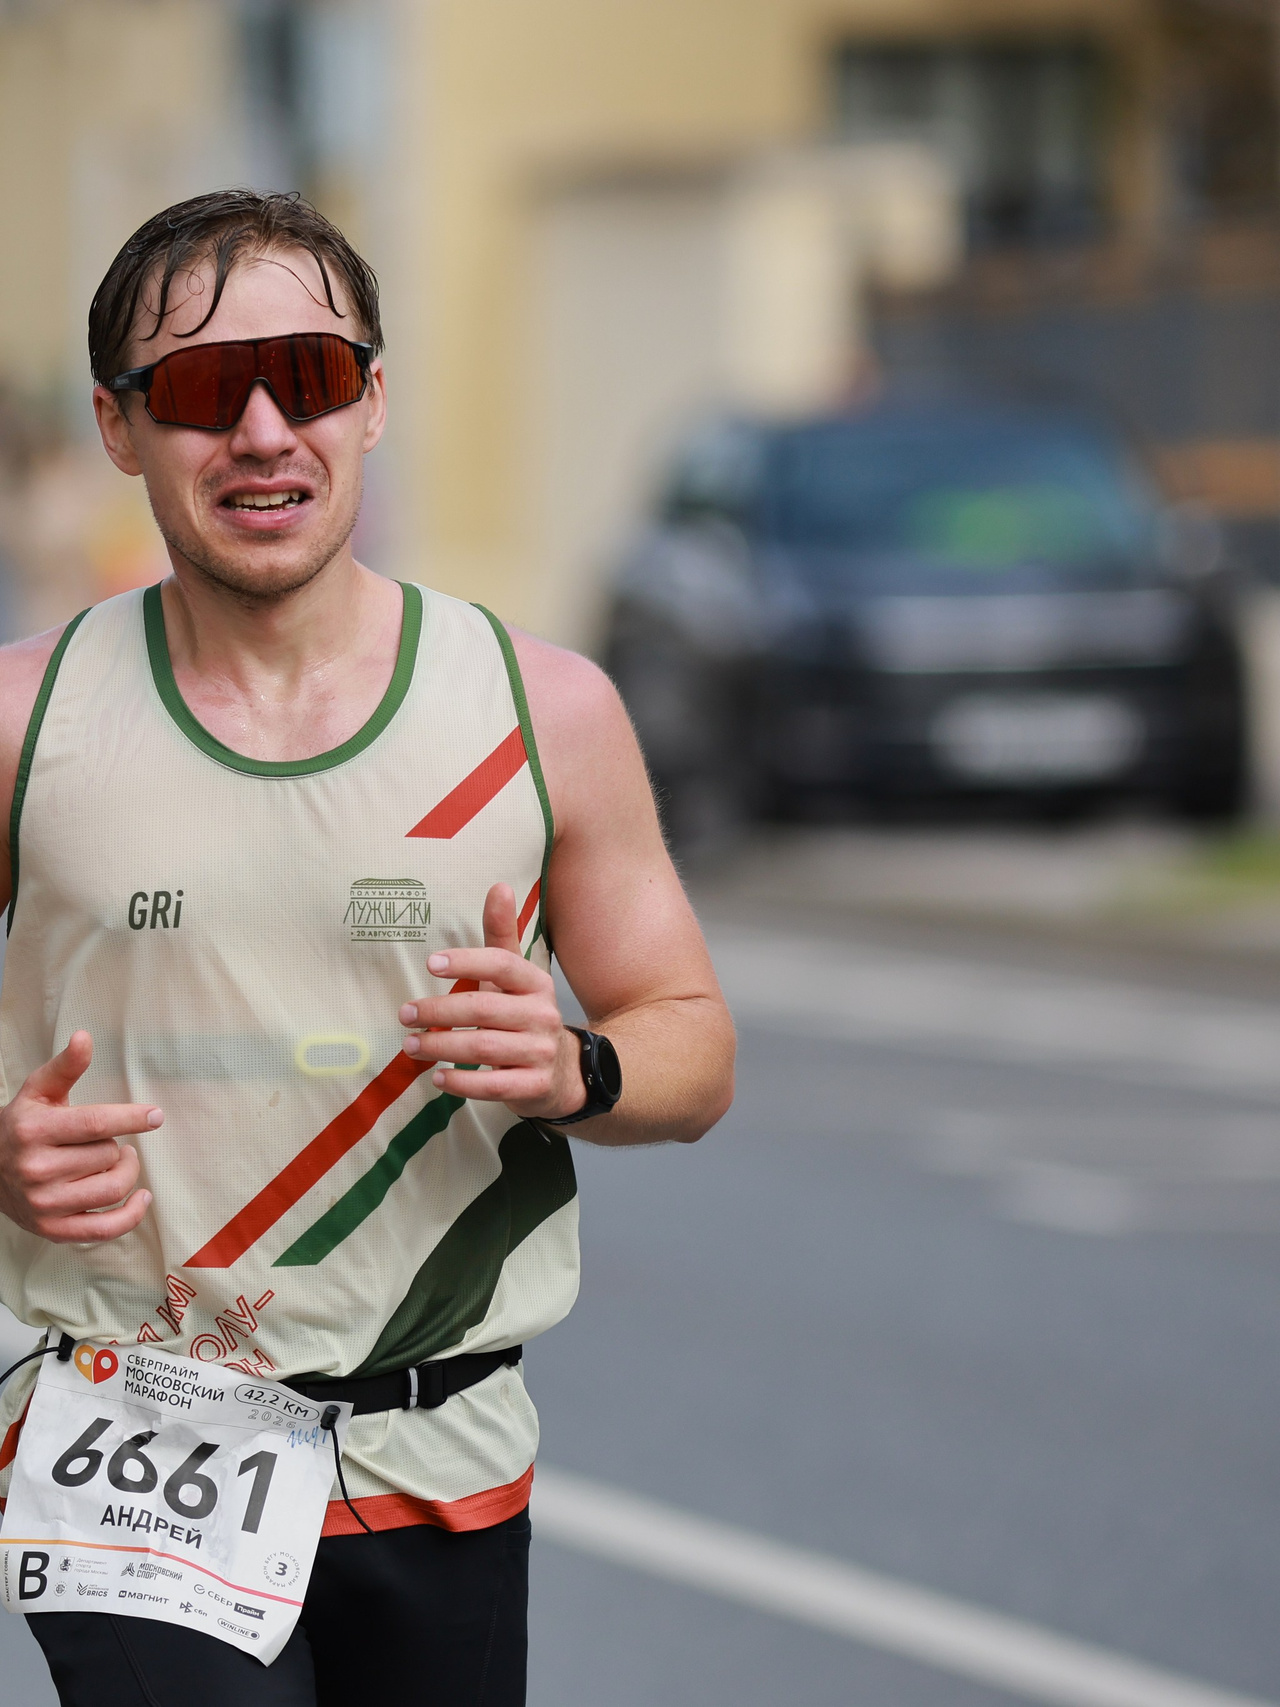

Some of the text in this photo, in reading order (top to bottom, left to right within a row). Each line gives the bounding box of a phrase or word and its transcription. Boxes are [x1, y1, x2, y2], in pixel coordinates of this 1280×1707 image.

[128, 889, 184, 931] GRi
[343, 900, 431, 925] ЛУЖНИКИ
[190, 1289, 275, 1363] ОЛУ-
[127, 1354, 199, 1381] СБЕРПРАЙМ
[124, 1380, 192, 1410] МАРАФОН
[125, 1365, 225, 1402] МОСКОВСКИЙ
[243, 1389, 309, 1418] 42,2 КМ
[51, 1417, 278, 1534] 6661
[100, 1504, 203, 1549] АНДРЕЙ
[18, 1551, 50, 1600] B
[136, 1570, 158, 1581] СПОРТ
[139, 1562, 183, 1581] МОСКОВСКИЙ
[275, 1562, 288, 1576] 3
[86, 1590, 108, 1598] BRICS
[207, 1590, 260, 1617] СБЕР Прайм
[220, 1620, 250, 1636] WINLINE
